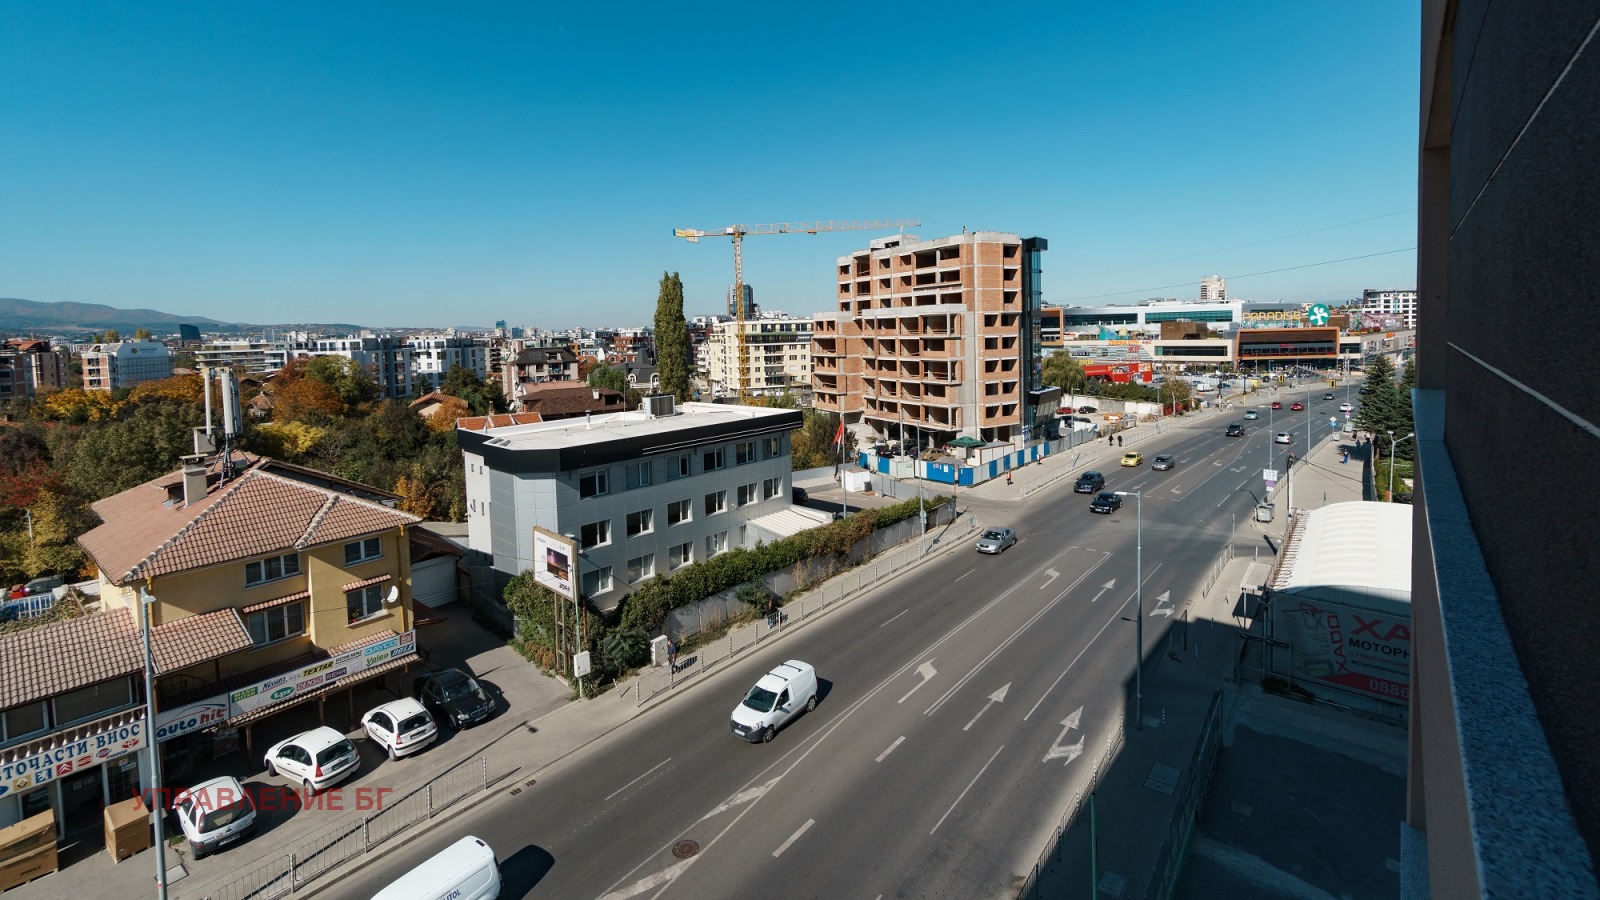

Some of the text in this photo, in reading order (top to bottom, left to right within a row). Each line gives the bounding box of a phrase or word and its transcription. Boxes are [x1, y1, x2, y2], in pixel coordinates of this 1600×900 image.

[1242, 310, 1300, 321] PARADISE
[364, 639, 397, 654] DAYCO
[366, 653, 389, 665] Valeo
[303, 661, 334, 677] TEXTAR
